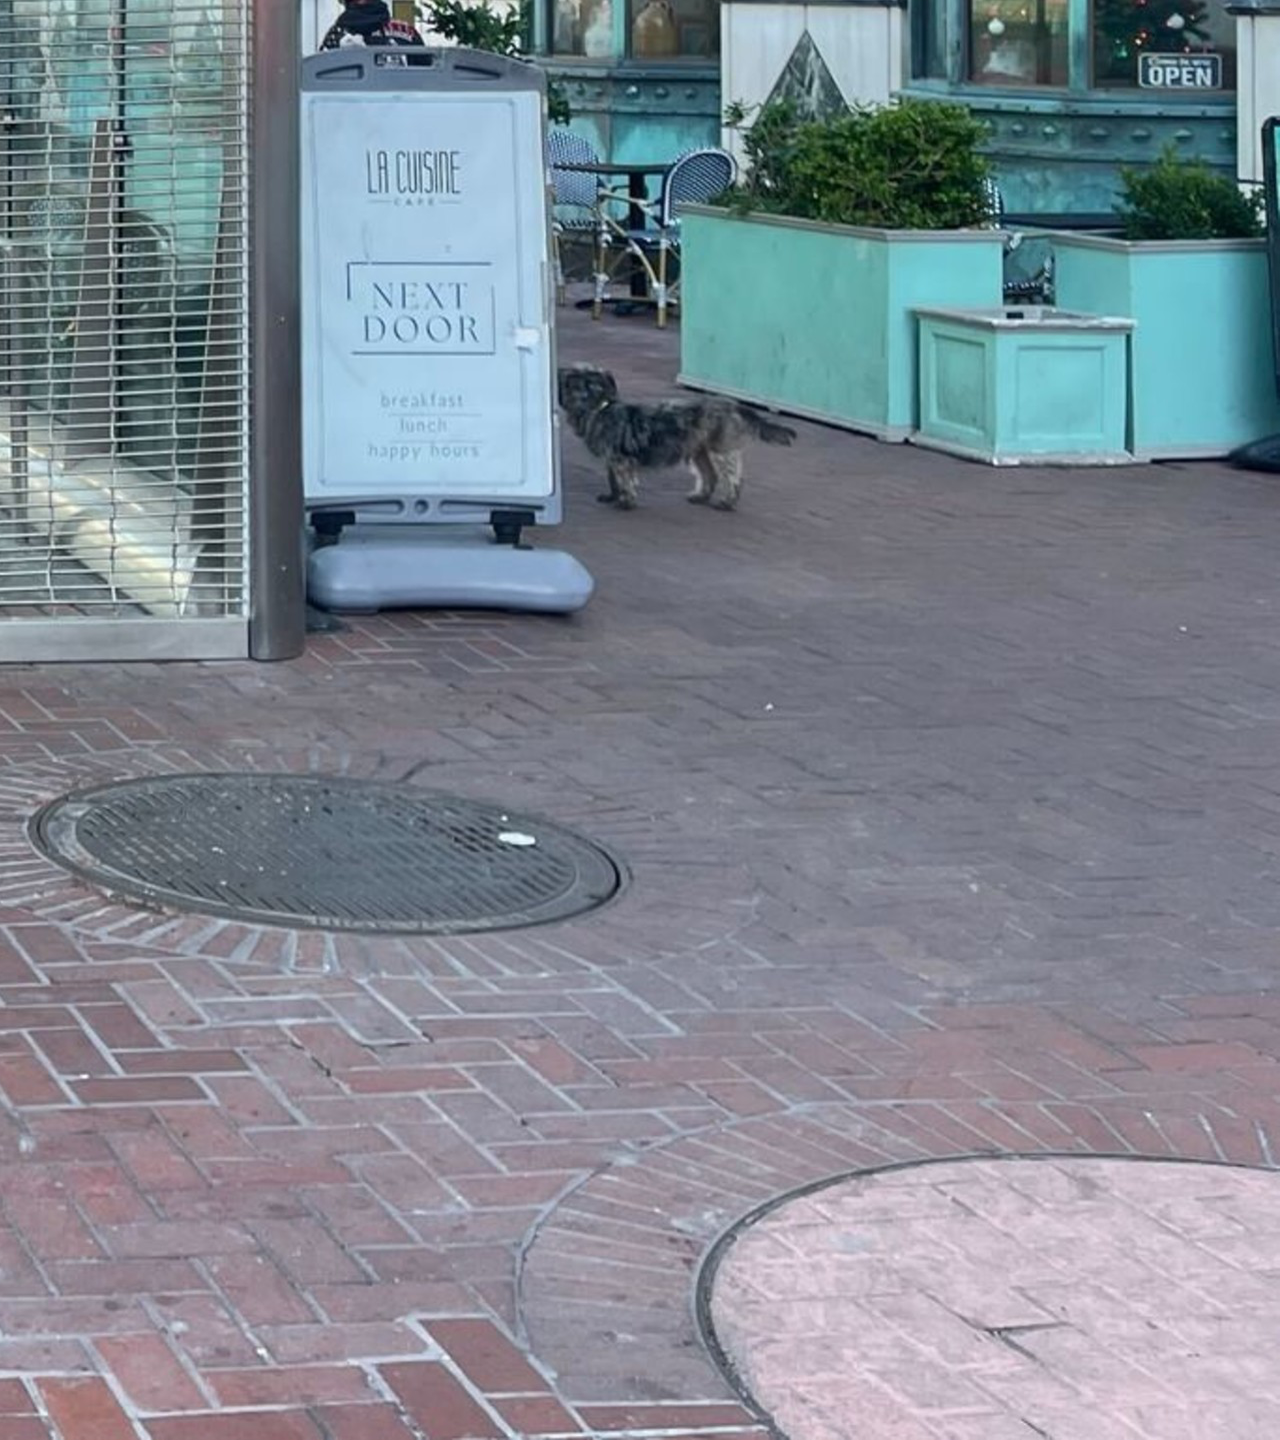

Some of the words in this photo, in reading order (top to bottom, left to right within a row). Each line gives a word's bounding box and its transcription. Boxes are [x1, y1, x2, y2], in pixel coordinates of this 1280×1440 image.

[1148, 67, 1213, 87] OPEN
[367, 150, 390, 195] LA
[395, 150, 462, 195] CUISINE
[372, 281, 469, 311] NEXT
[363, 314, 480, 344] DOOR
[380, 392, 463, 408] breakfast
[399, 417, 448, 433] lunch
[367, 442, 422, 462] happy
[429, 441, 480, 458] hours
